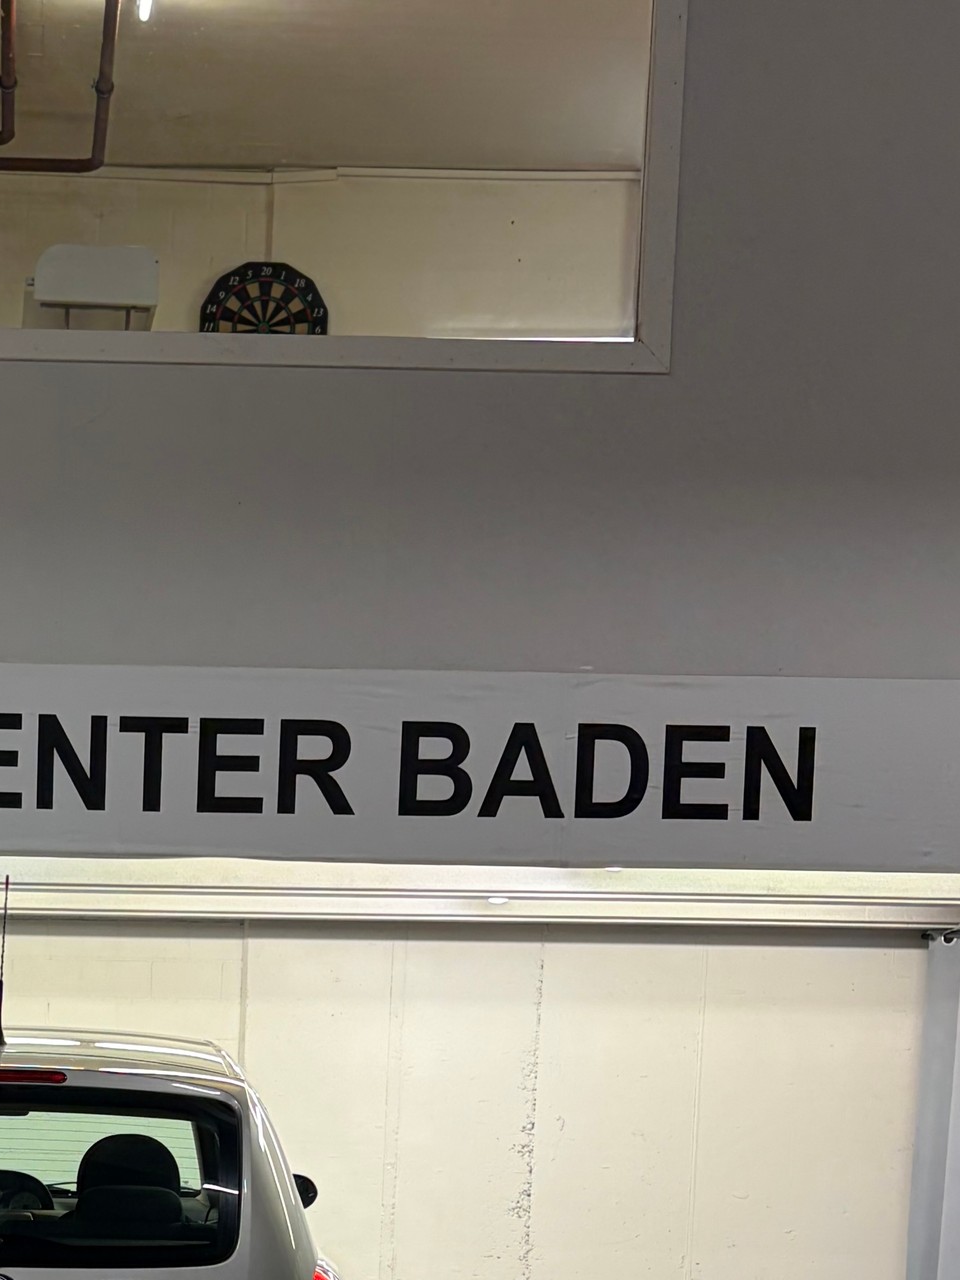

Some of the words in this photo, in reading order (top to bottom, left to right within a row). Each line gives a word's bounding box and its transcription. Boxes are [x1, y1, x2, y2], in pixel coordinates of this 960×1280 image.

[246, 270, 253, 279] 5
[261, 266, 273, 276] 20
[280, 271, 286, 280] 1
[228, 276, 239, 285] 12
[294, 278, 306, 288] 18
[219, 291, 226, 299] 9
[306, 293, 313, 302] 4
[206, 304, 217, 313] 14
[313, 308, 324, 317] 13
[203, 322, 214, 331] 11
[315, 325, 321, 334] 6
[397, 720, 817, 822] BADEN
